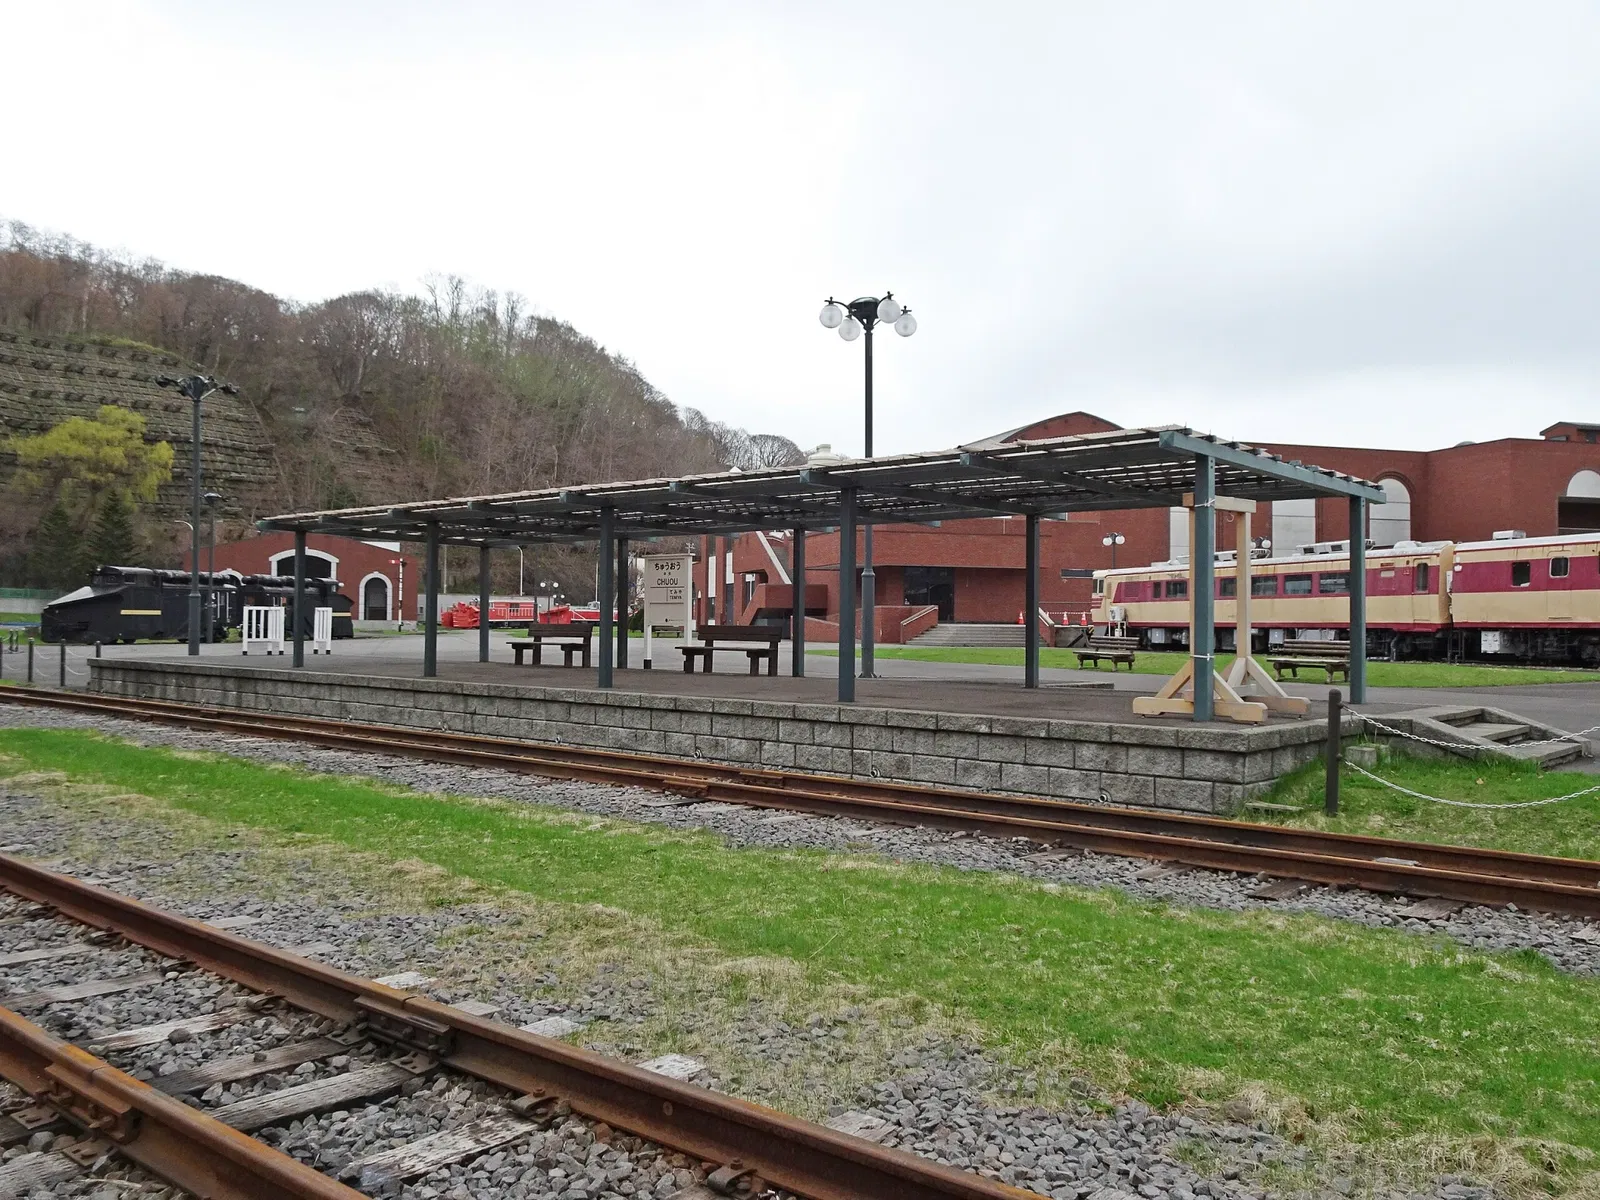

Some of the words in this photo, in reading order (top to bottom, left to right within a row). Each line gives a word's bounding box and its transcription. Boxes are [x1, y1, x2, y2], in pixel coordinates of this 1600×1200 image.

[654, 561, 681, 571] ちゅうおう
[656, 578, 679, 586] CHUOU
